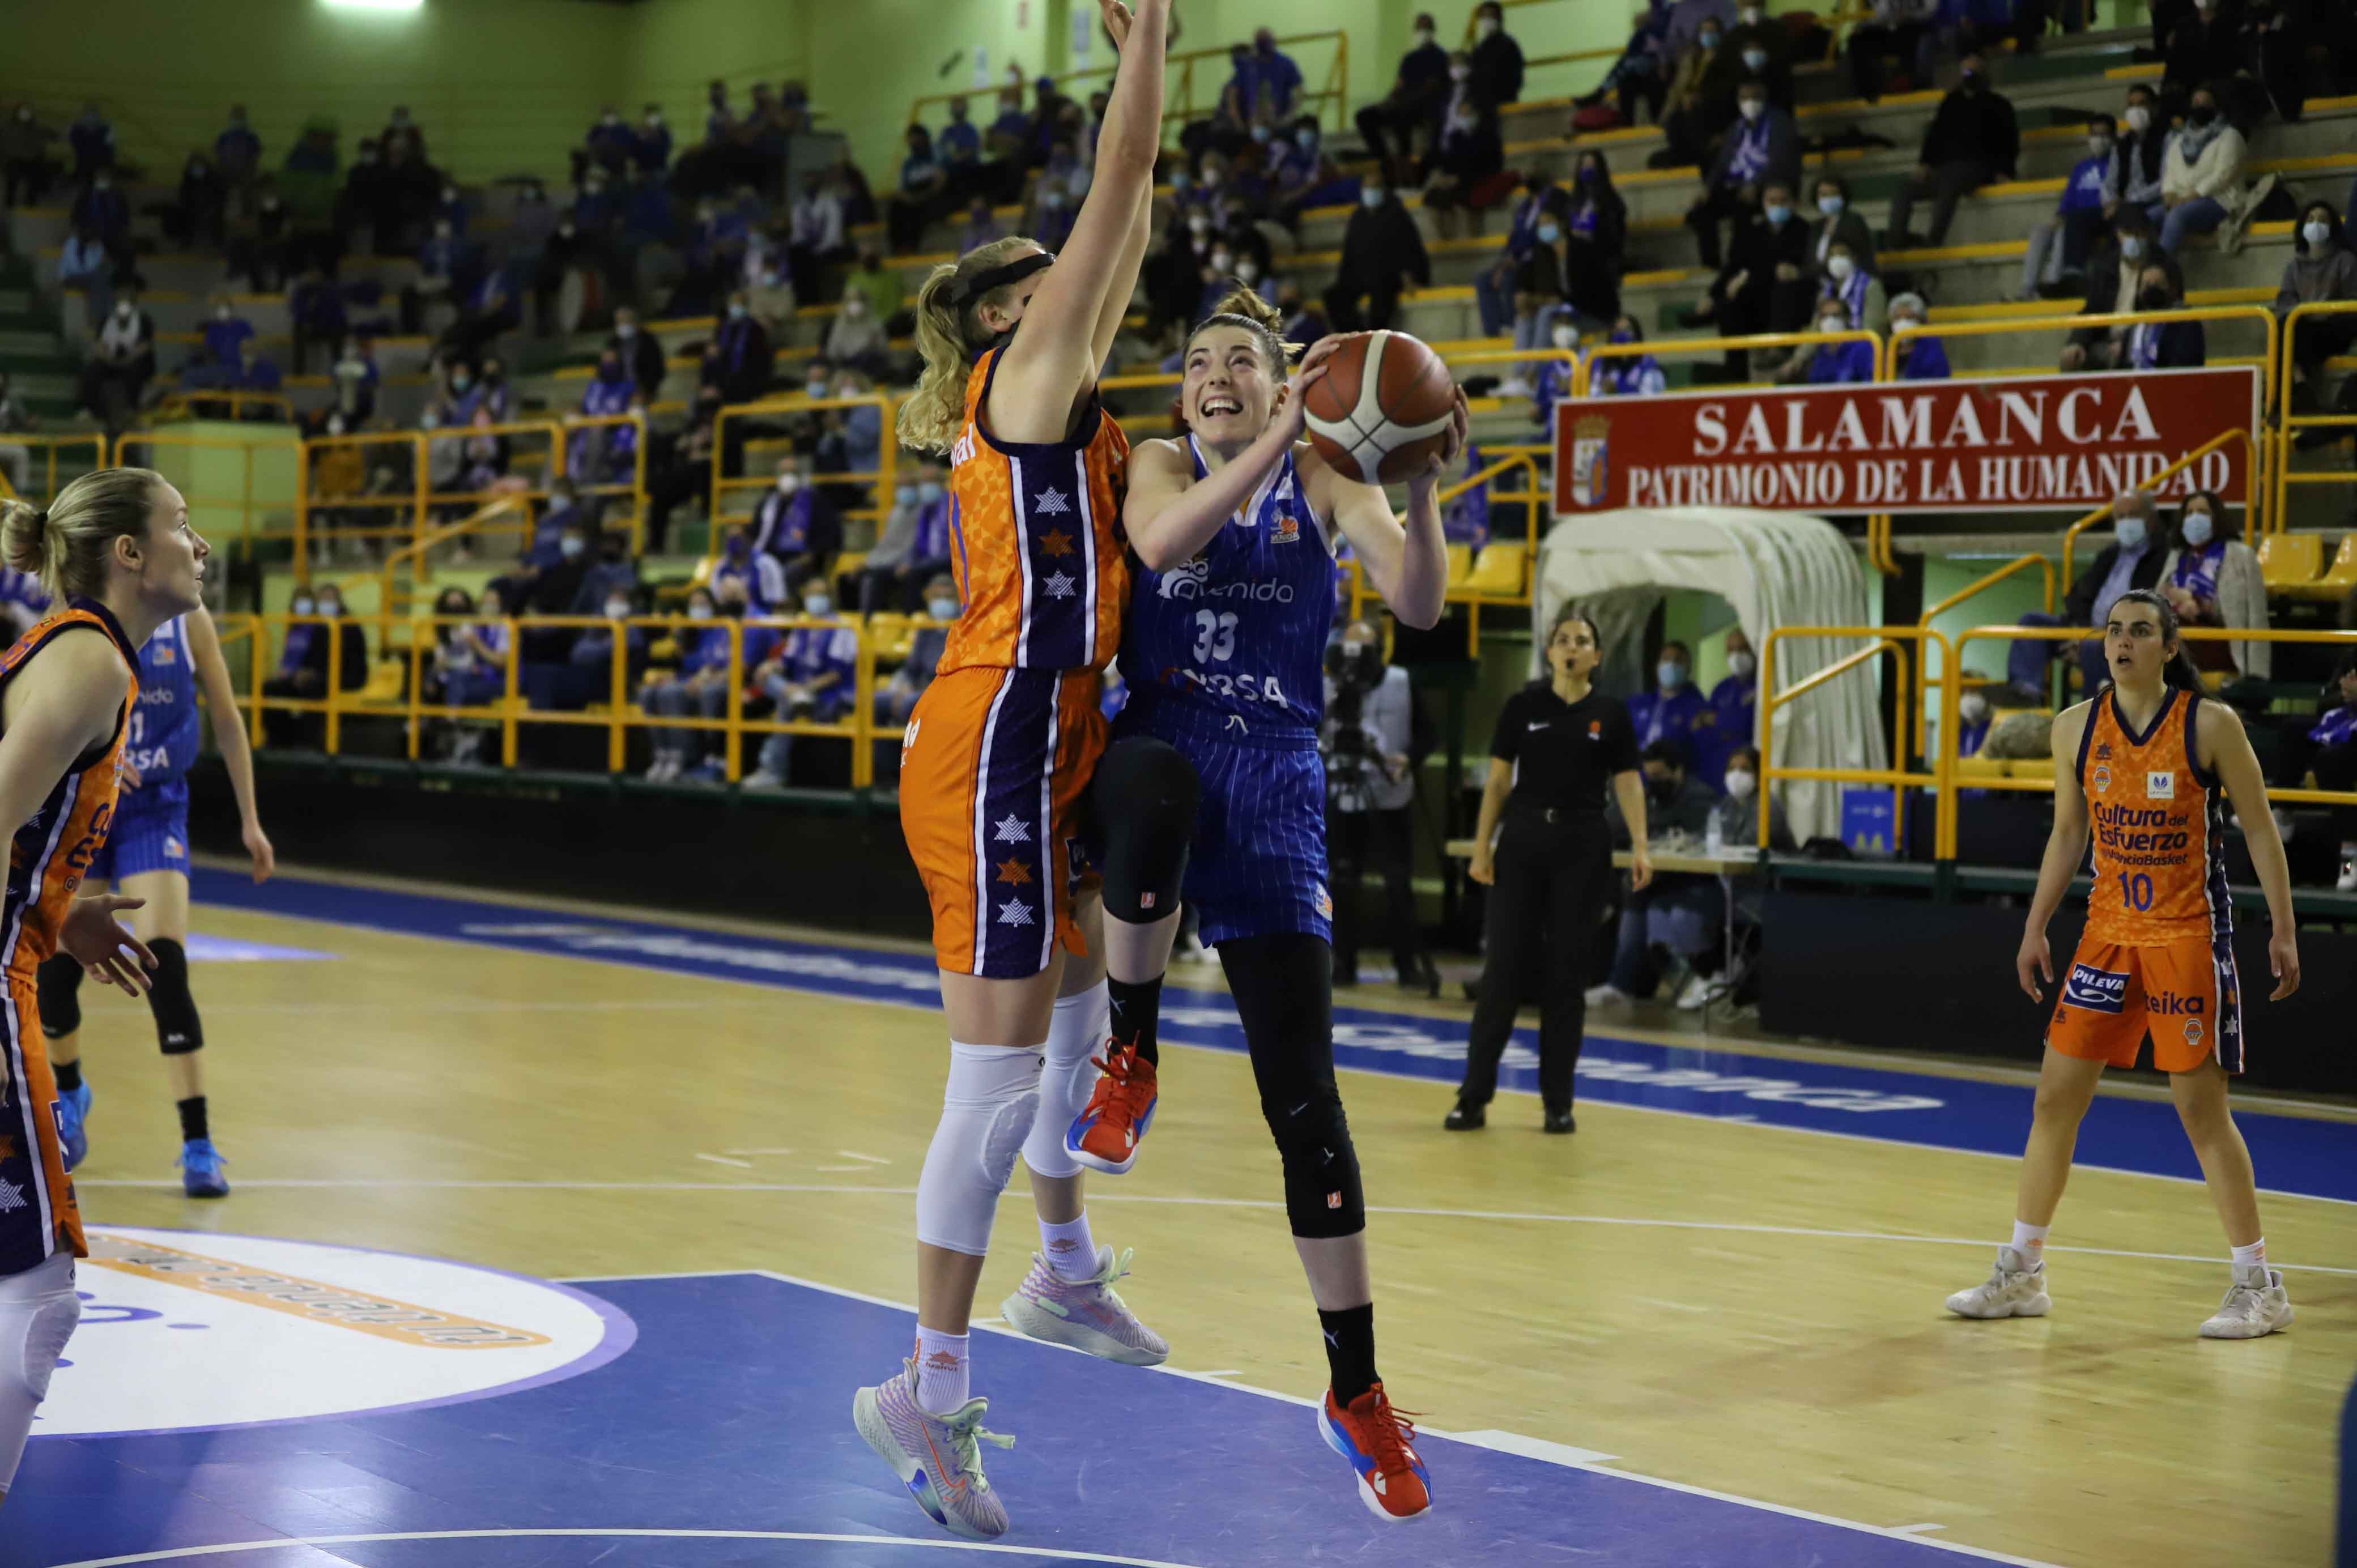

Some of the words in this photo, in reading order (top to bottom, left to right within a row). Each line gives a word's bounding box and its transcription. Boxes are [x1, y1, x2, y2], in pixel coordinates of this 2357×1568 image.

[1693, 385, 2162, 455] SALAMANCA
[1627, 459, 1845, 508] PATRIMONIO
[1856, 458, 1908, 503] DE
[1920, 457, 1965, 501] LA
[1978, 449, 2231, 500] HUMANIDAD
[1193, 609, 1239, 664] 33
[2094, 802, 2167, 826] Cultura
[2168, 815, 2188, 825] del
[2099, 824, 2188, 851] Esfuerzo
[2117, 871, 2152, 911] 10
[2072, 969, 2125, 991] PILEVA
